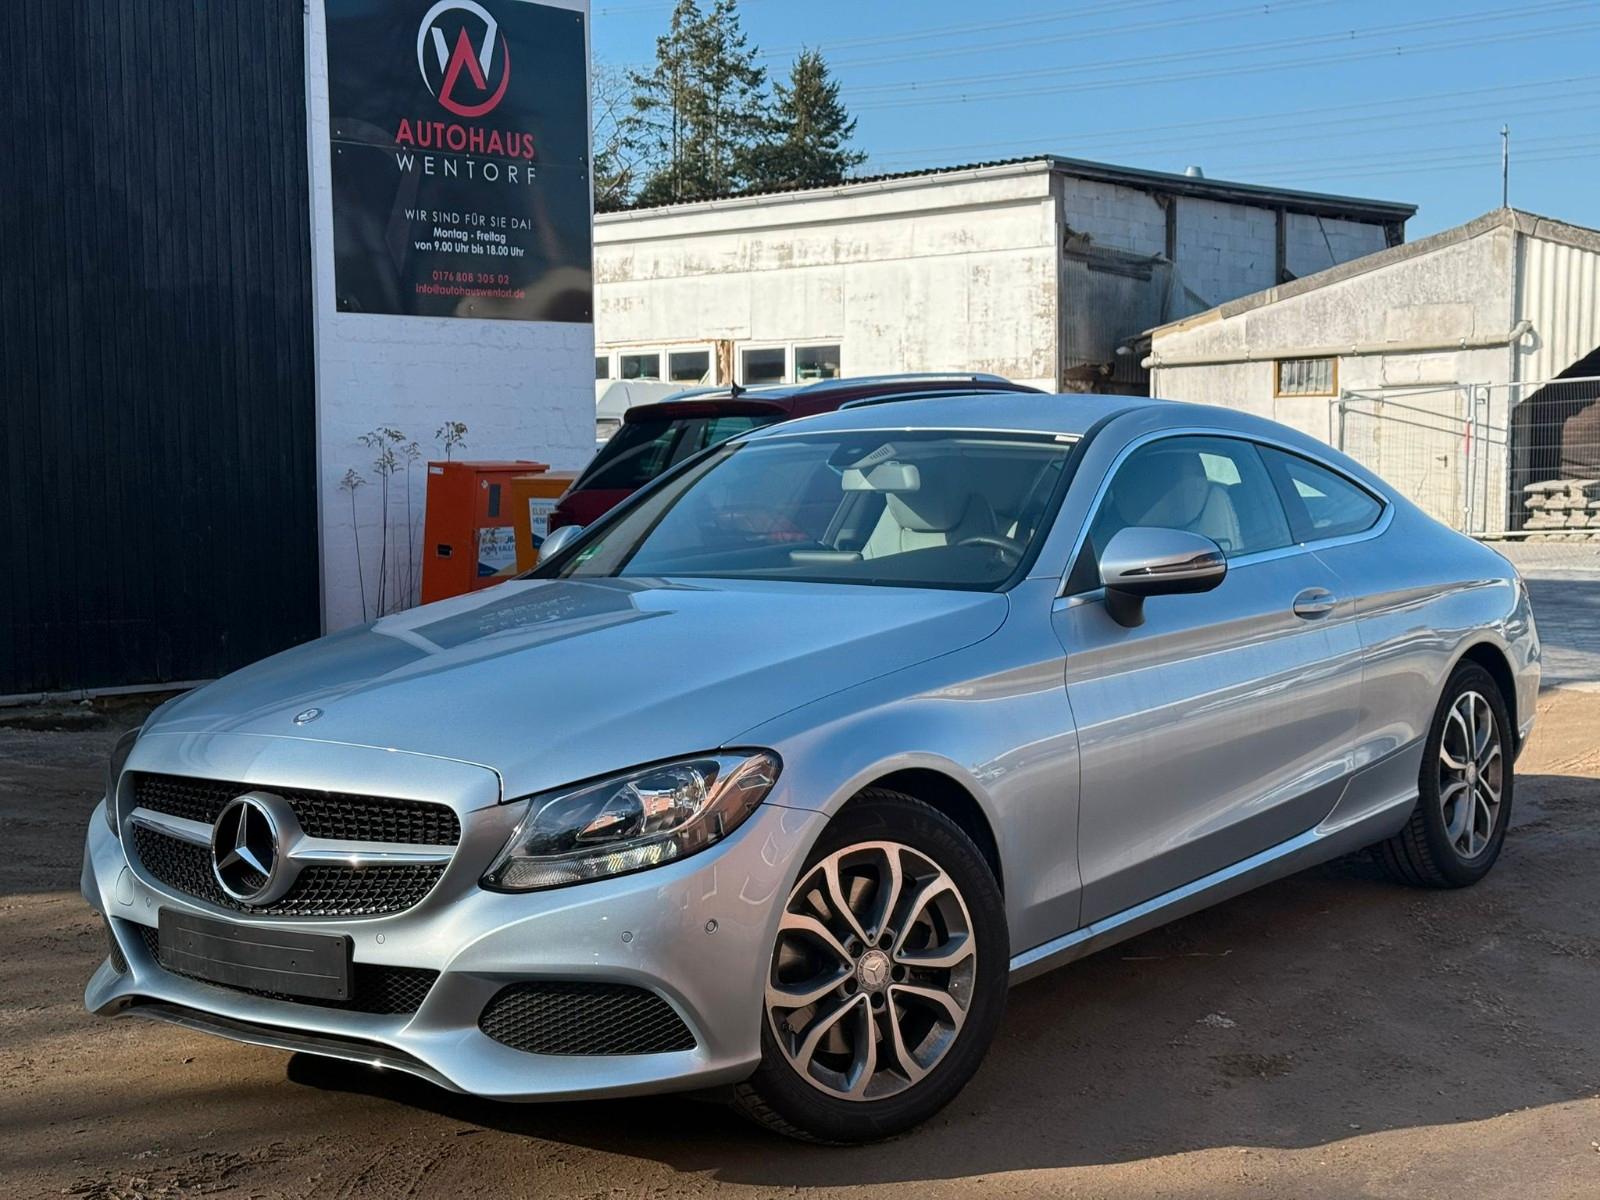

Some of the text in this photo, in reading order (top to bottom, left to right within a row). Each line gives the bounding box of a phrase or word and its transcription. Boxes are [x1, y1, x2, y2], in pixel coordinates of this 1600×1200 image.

[395, 118, 535, 159] AUTOHAUS
[395, 152, 536, 185] WENTORF
[404, 208, 427, 222] WIR
[432, 211, 460, 224] SIND
[465, 212, 485, 226] FÜR
[490, 216, 506, 228] SIE
[433, 227, 468, 241] Montag
[476, 230, 506, 244] Freitag
[414, 241, 525, 257] von 9.00 Uhr bis 18.00 Uhr
[432, 270, 454, 281] 0176
[498, 274, 509, 285] 02
